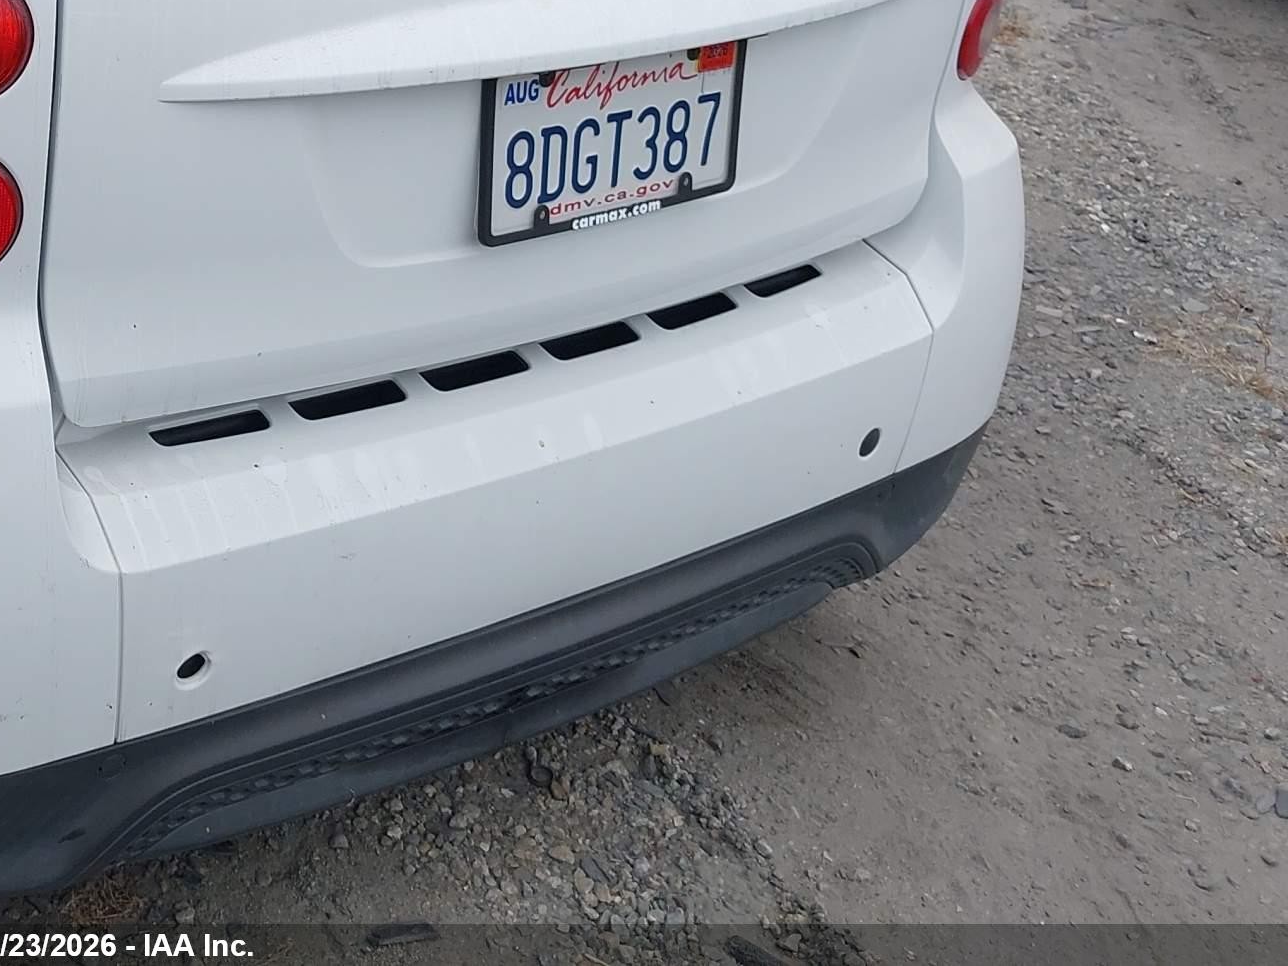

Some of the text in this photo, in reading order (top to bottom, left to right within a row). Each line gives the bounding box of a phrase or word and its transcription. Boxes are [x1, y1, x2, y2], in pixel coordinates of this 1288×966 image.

[504, 62, 698, 110] AUG California
[505, 91, 721, 210] 8DGT387
[550, 178, 675, 216] dmv.ca.gov
[571, 198, 662, 231] carmax.com
